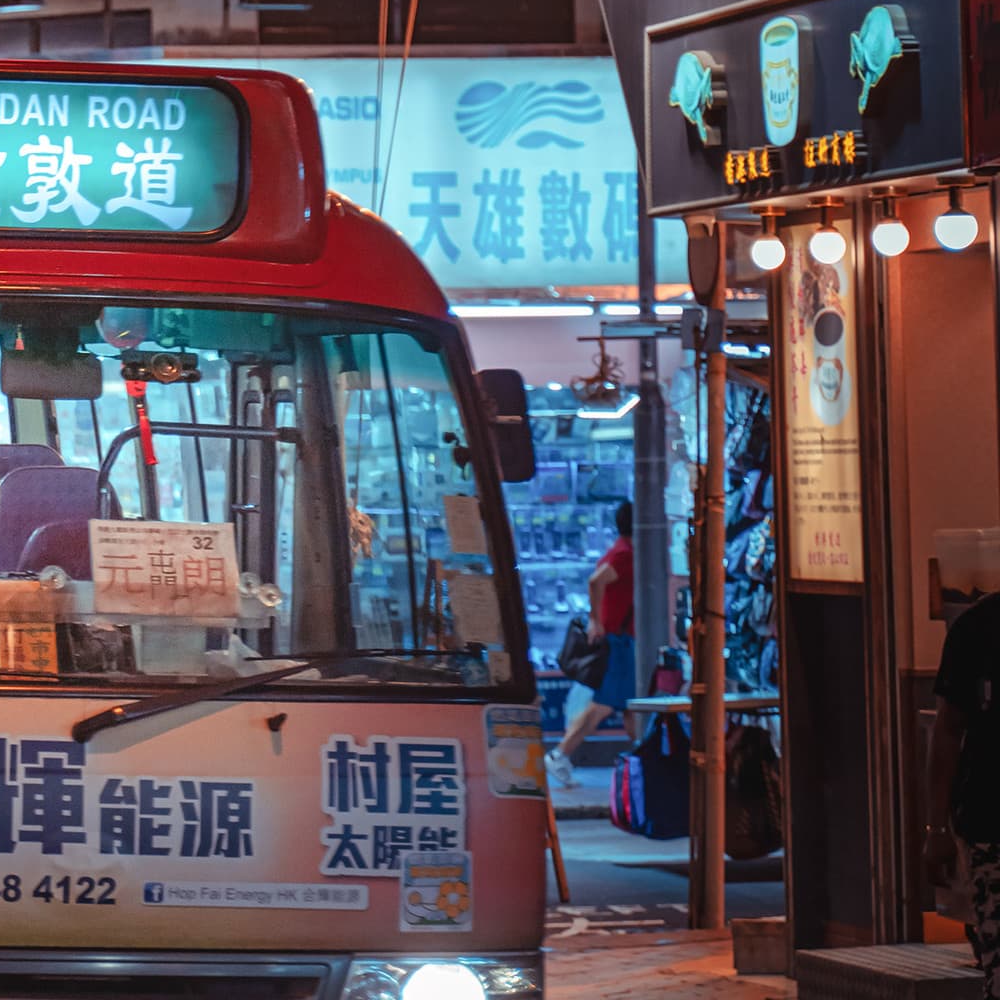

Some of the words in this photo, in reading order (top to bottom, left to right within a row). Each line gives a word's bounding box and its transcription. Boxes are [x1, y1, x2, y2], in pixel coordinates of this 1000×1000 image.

[88, 96, 187, 131] ROAD
[319, 96, 381, 122] ASIO
[192, 536, 214, 550] 32
[327, 740, 460, 816] 村屋
[32, 875, 117, 905] 4122
[168, 887, 196, 902] Hop
[200, 887, 222, 900] Fai
[226, 887, 273, 904] Energy
[277, 889, 297, 901] HK
